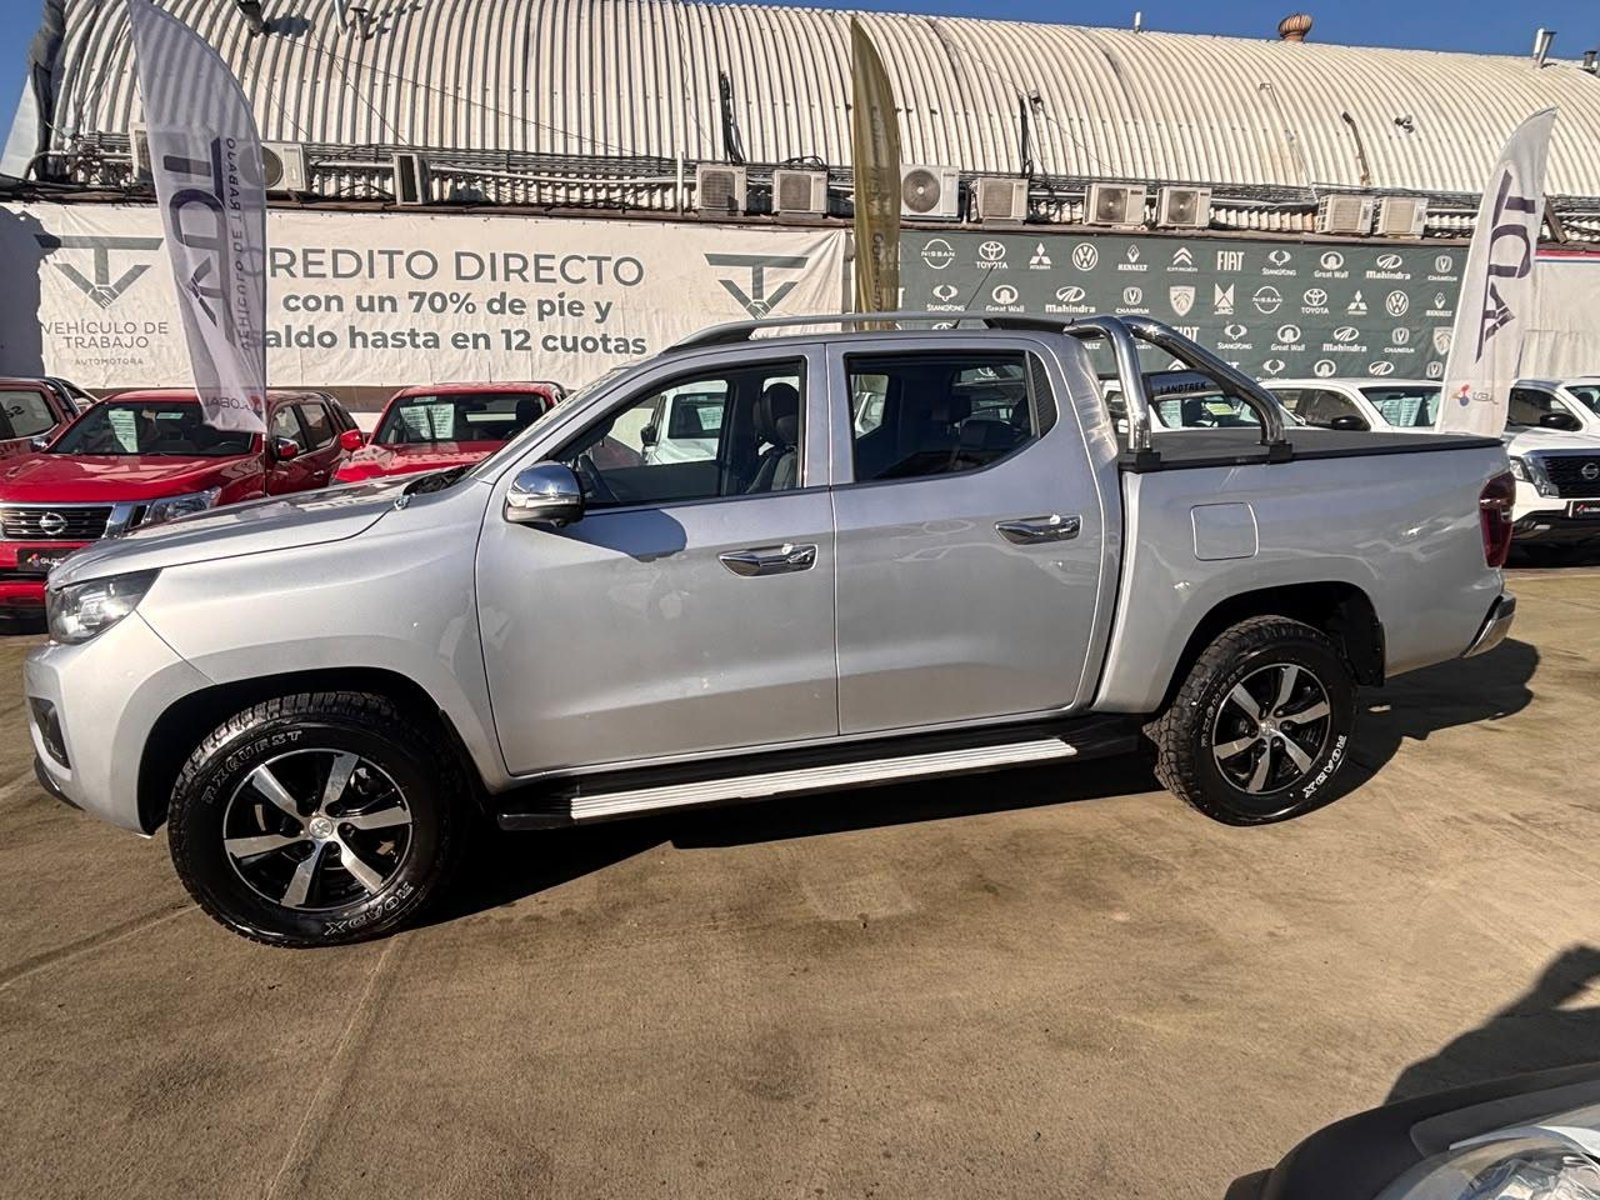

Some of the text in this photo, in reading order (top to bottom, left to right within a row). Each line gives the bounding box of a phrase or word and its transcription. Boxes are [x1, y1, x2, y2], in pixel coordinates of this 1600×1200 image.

[976, 261, 1008, 269] TOYOTA
[1216, 251, 1245, 271] FIAT
[455, 251, 644, 286] DIRECTO
[1366, 271, 1411, 280] Mahindra
[282, 291, 613, 323] con un 70% de pie y
[1045, 304, 1097, 313] Mahindra
[144, 322, 168, 334] DE
[62, 336, 149, 349] TRABAJO
[349, 326, 440, 350] hasta
[451, 332, 491, 350] en
[501, 329, 532, 351] 12
[541, 333, 647, 354] cuotas
[1322, 344, 1367, 352] Mahindra
[1160, 381, 1207, 394] LANDTREK
[1302, 735, 1347, 798] ROADX
[324, 881, 414, 936] ROADX
